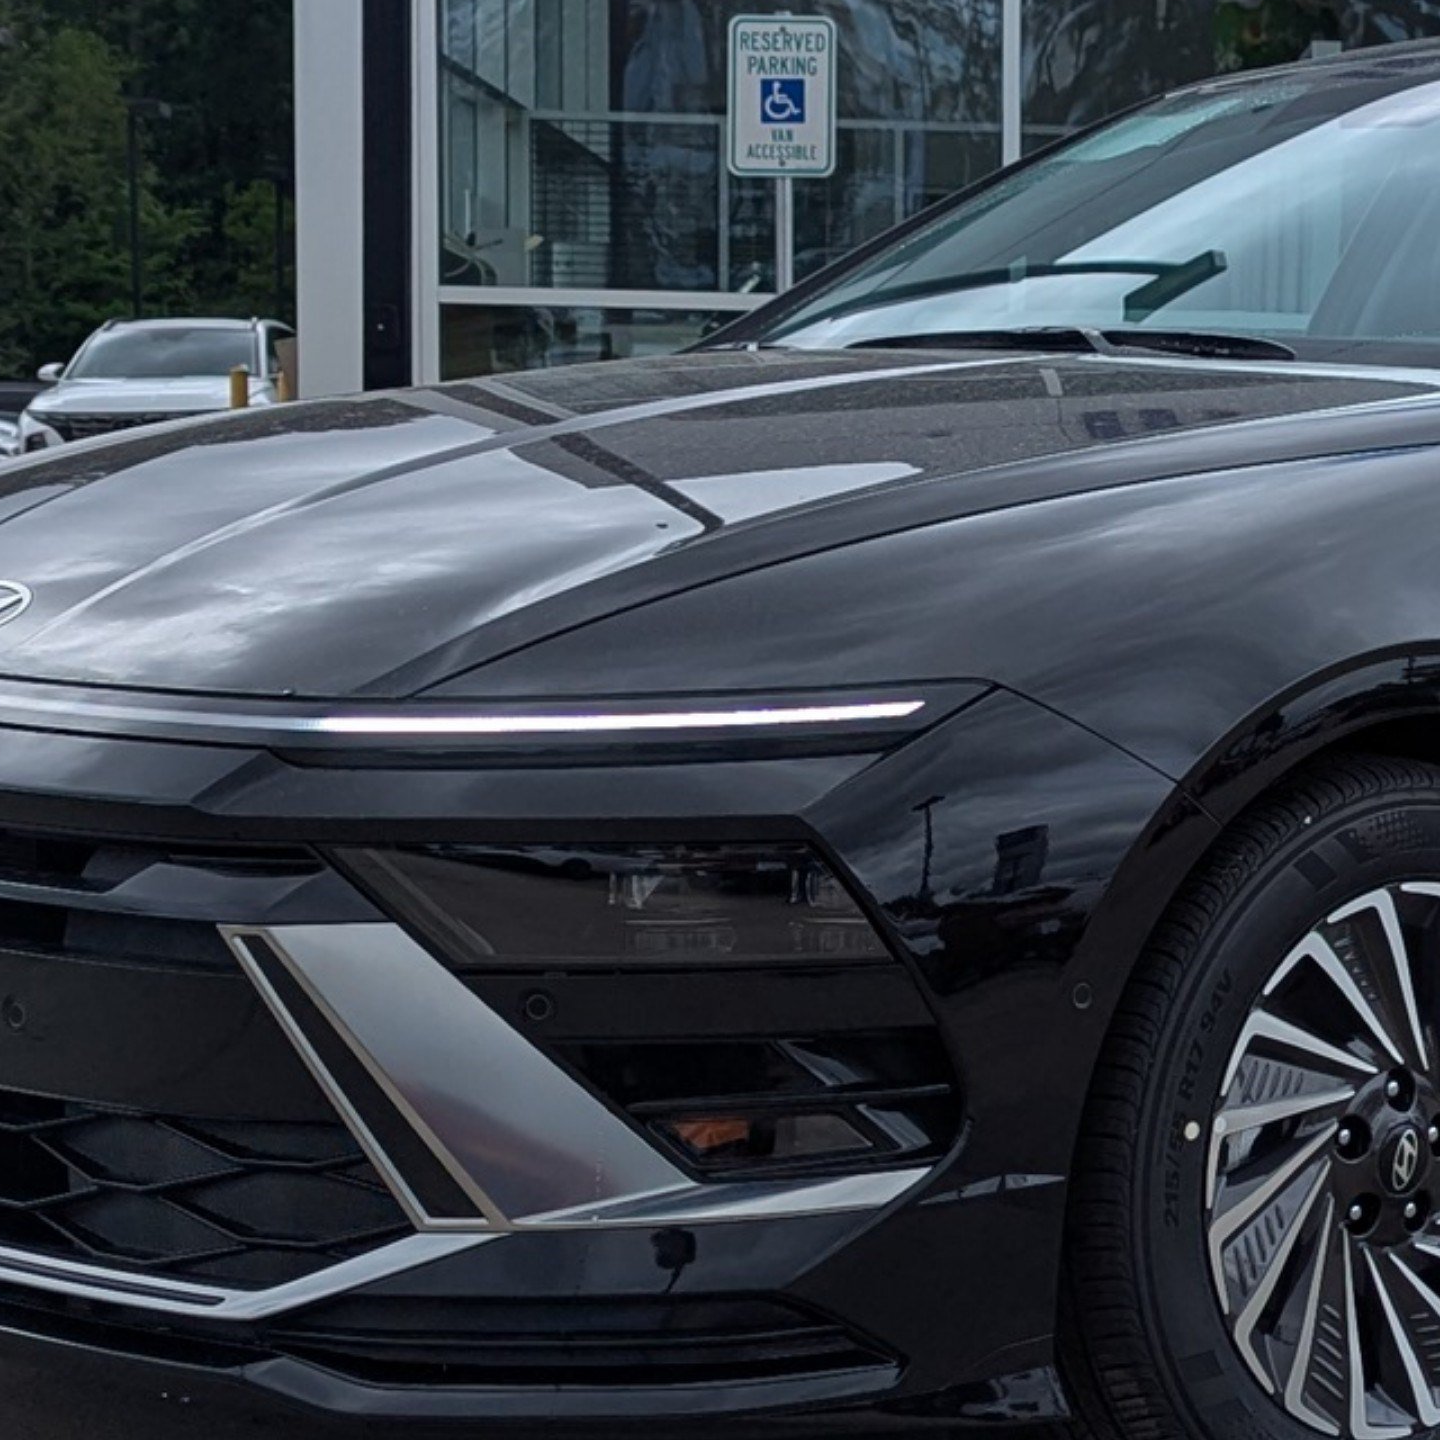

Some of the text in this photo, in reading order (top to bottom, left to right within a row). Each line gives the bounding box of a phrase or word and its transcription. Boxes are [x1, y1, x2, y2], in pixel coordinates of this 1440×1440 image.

[740, 31, 826, 52] RESERVED
[747, 55, 818, 76] PARKING
[771, 128, 794, 142] VAN
[746, 144, 818, 161] ACCESSIBLE
[1177, 1039, 1204, 1101] R17
[1198, 967, 1232, 1035] 94V
